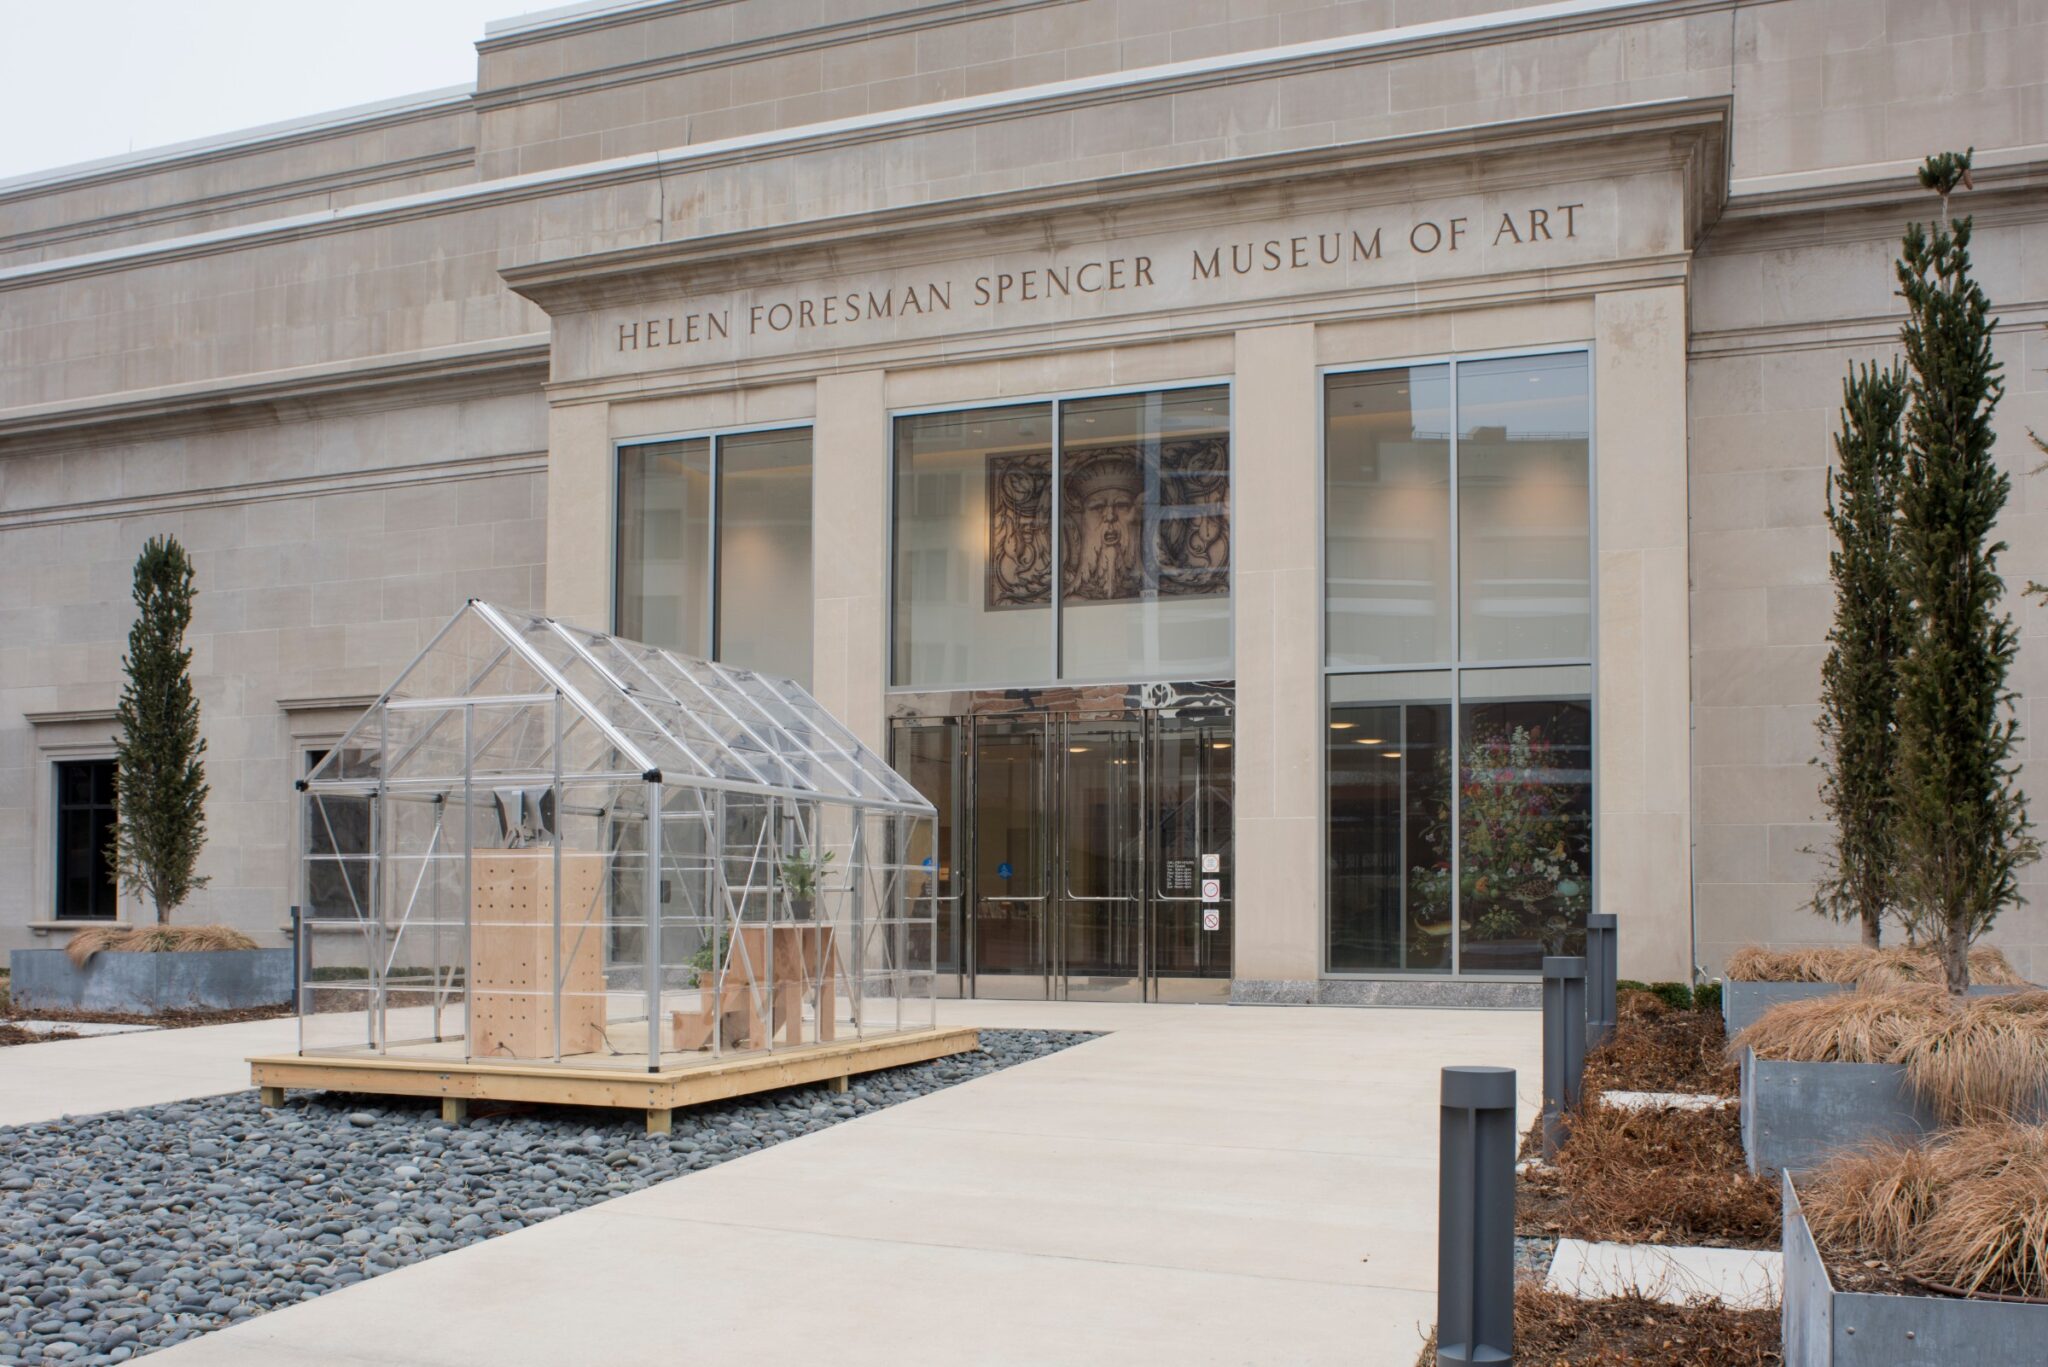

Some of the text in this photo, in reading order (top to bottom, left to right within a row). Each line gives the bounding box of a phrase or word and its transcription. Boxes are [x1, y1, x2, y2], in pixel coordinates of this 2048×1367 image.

[618, 203, 1584, 352] HELEN FORESMAN SPENCER MUSEUM OF ART
